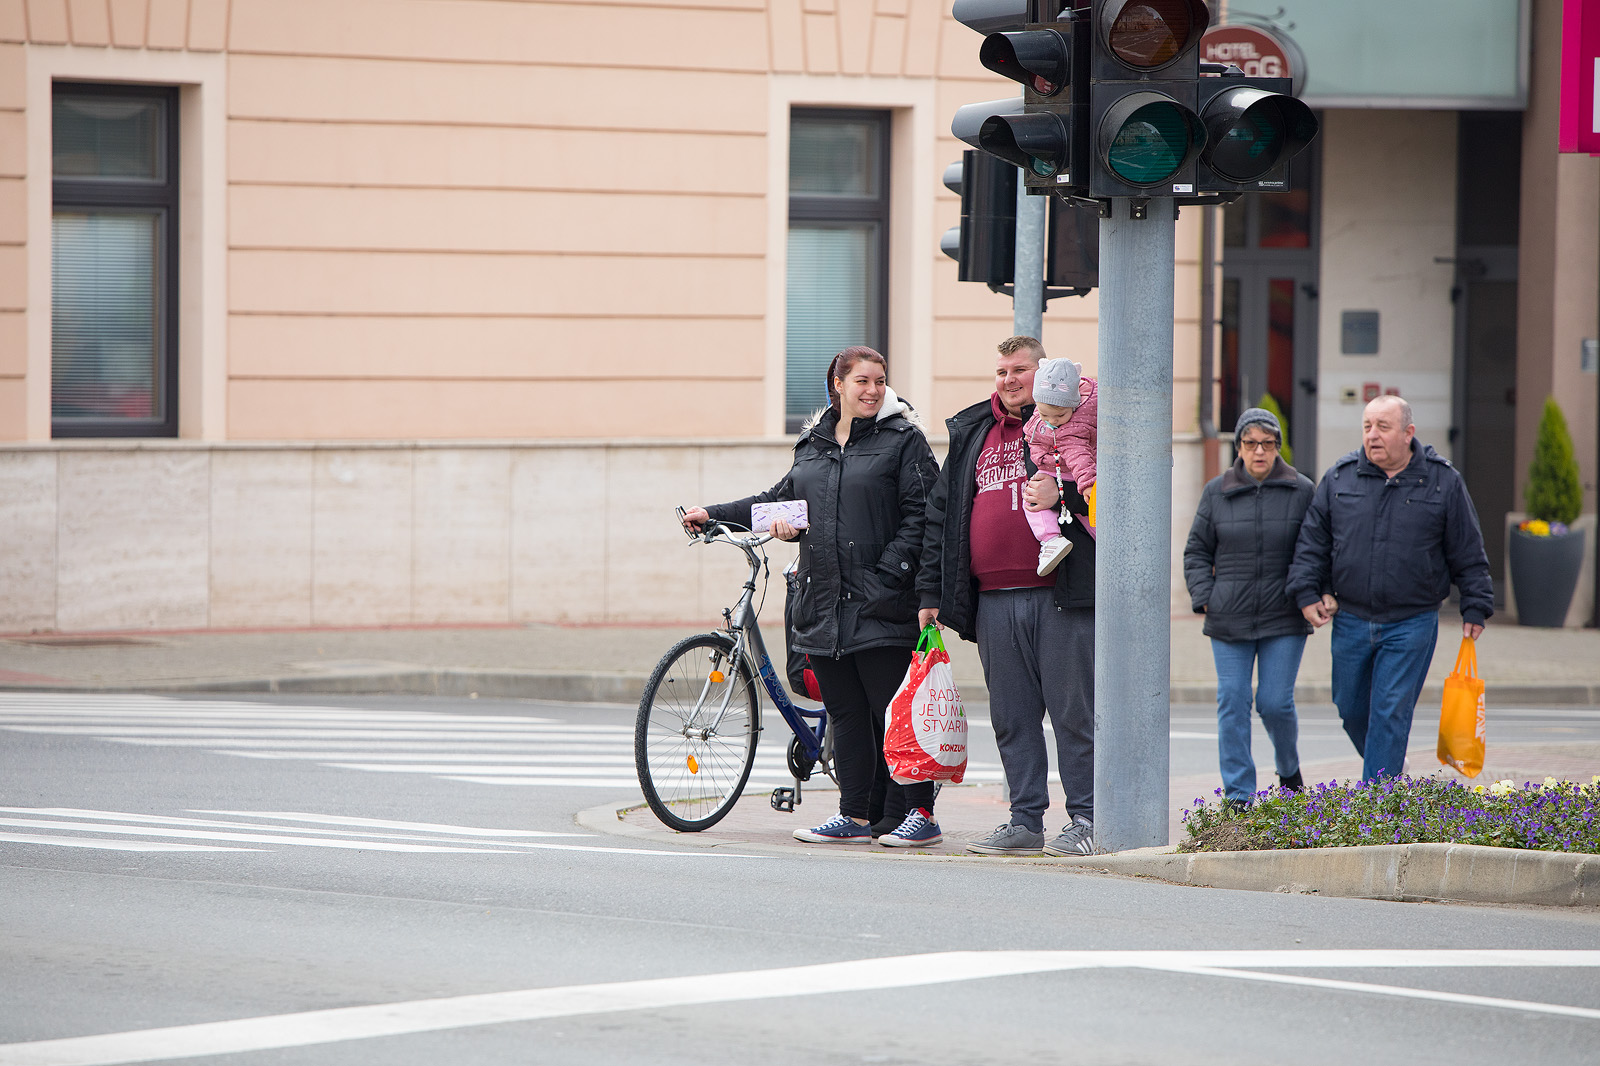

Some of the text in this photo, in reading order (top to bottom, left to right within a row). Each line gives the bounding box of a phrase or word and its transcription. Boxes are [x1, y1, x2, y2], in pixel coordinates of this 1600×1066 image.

[1206, 42, 1260, 59] HOTEL
[977, 465, 1024, 488] SERVICE
[919, 703, 934, 717] JE
[937, 703, 948, 717] U
[940, 743, 966, 753] KONZUM
